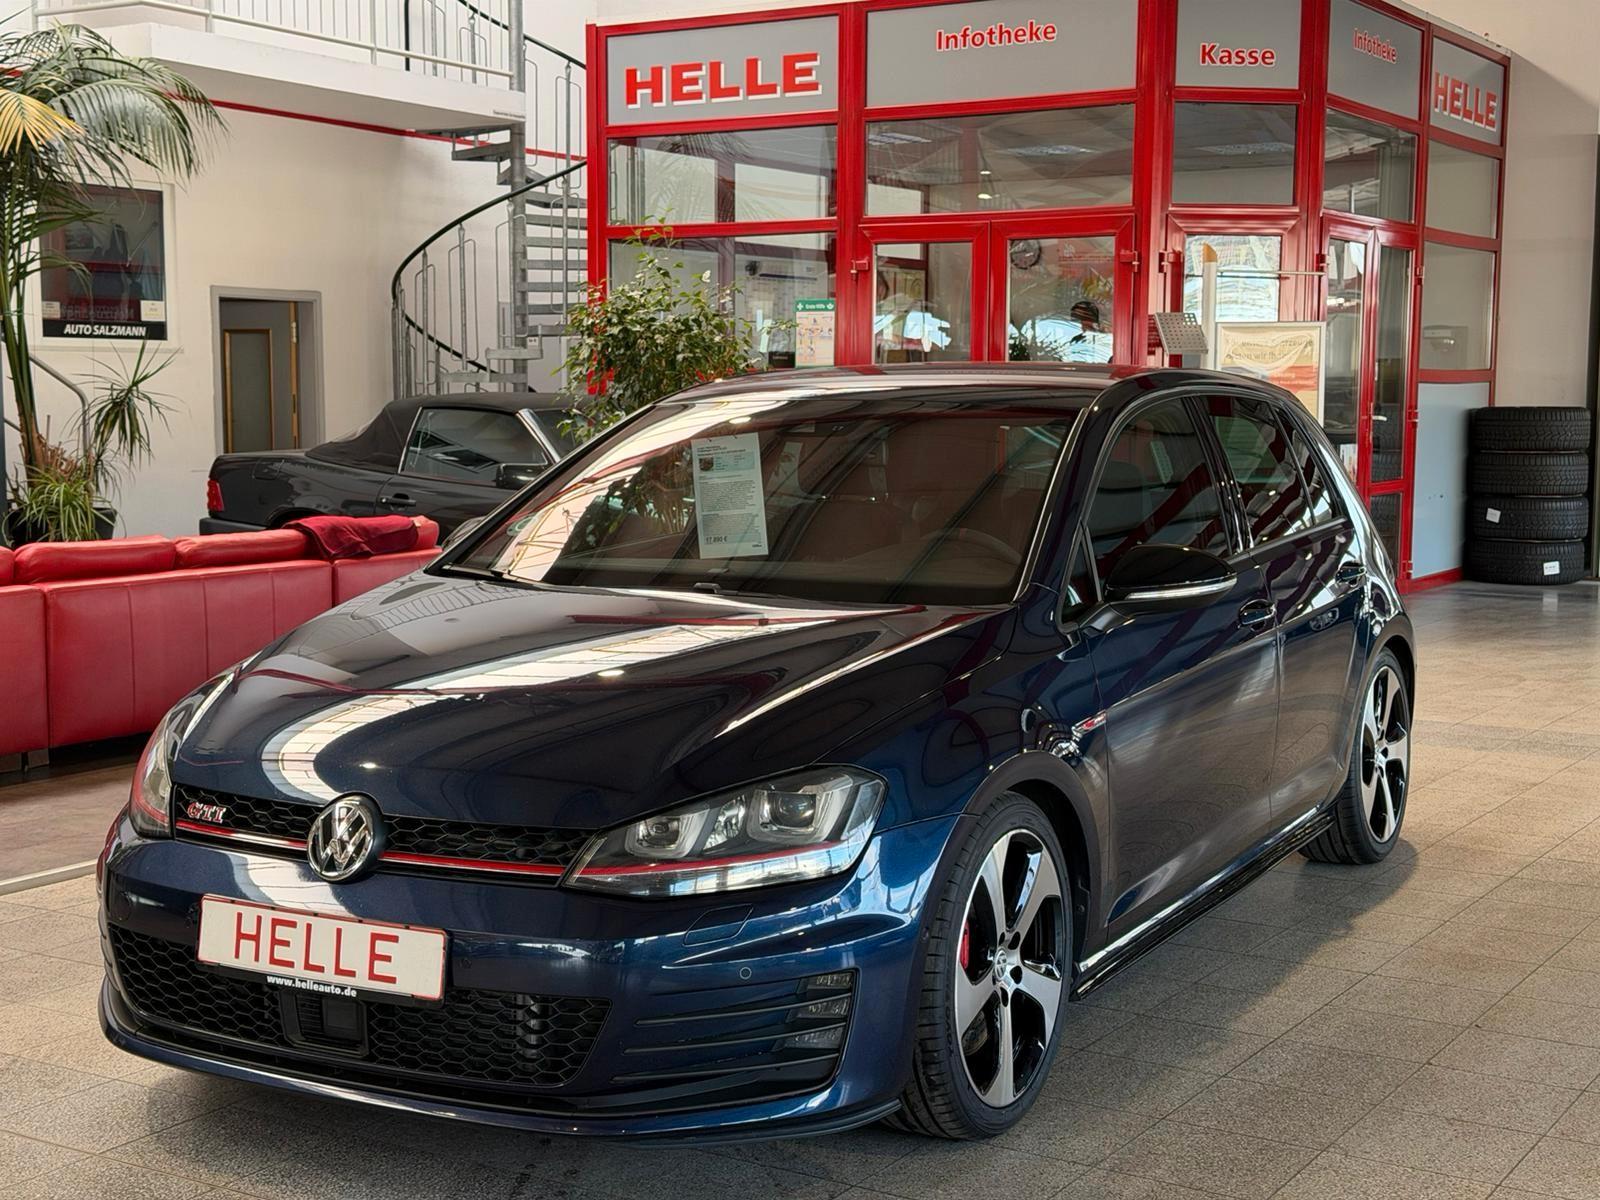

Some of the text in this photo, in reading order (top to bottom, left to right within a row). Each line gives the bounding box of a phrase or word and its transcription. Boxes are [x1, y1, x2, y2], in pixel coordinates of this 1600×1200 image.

[936, 19, 1057, 51] Infotheke
[1352, 27, 1398, 64] Infotheke
[1200, 42, 1276, 67] Kasse
[625, 52, 822, 109] HELLE
[1434, 71, 1497, 132] HELLE
[64, 324, 147, 337] AUTO SALZMANN
[187, 801, 227, 824] GTI
[234, 912, 399, 984] HELLE
[267, 974, 358, 998] www.helleauto.de
